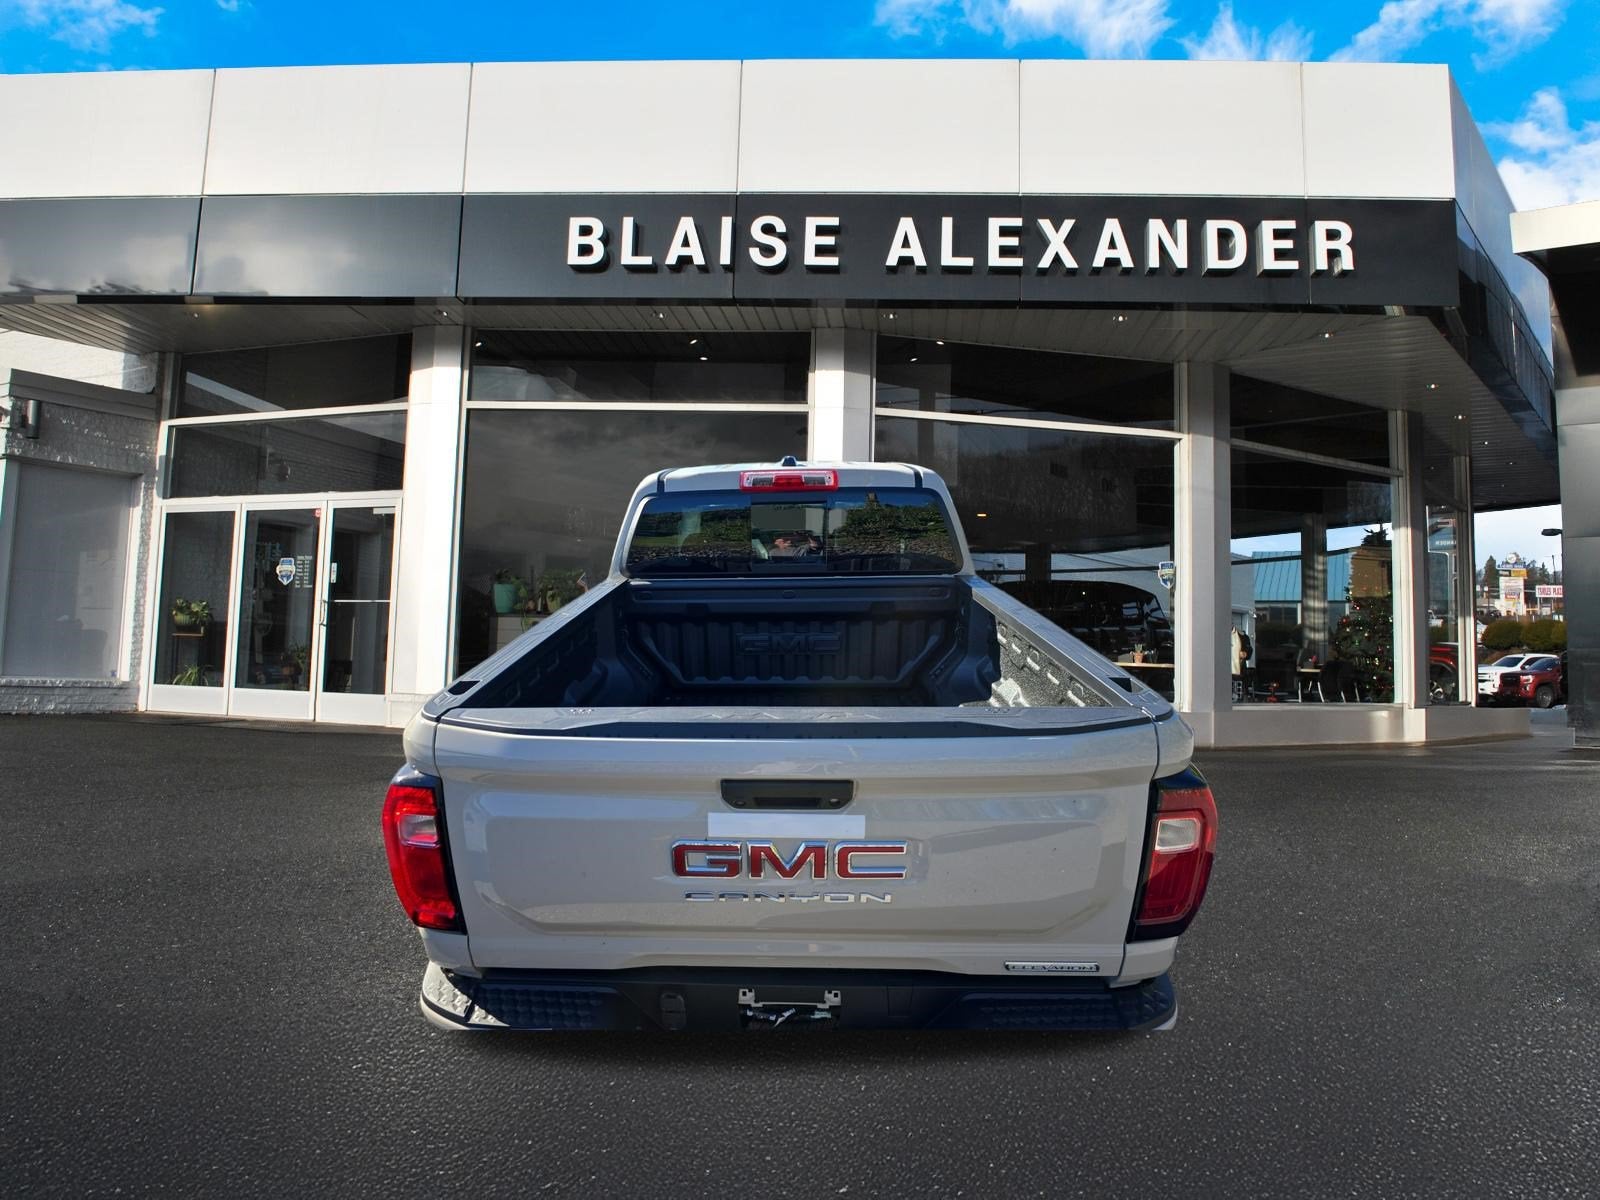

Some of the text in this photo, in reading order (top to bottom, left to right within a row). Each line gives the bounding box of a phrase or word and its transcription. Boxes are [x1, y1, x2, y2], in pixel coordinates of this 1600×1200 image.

[566, 215, 1356, 274] BLAISE ALEXANDER
[737, 632, 841, 655] GMC
[671, 840, 908, 881] GMC
[684, 891, 893, 905] CANYON
